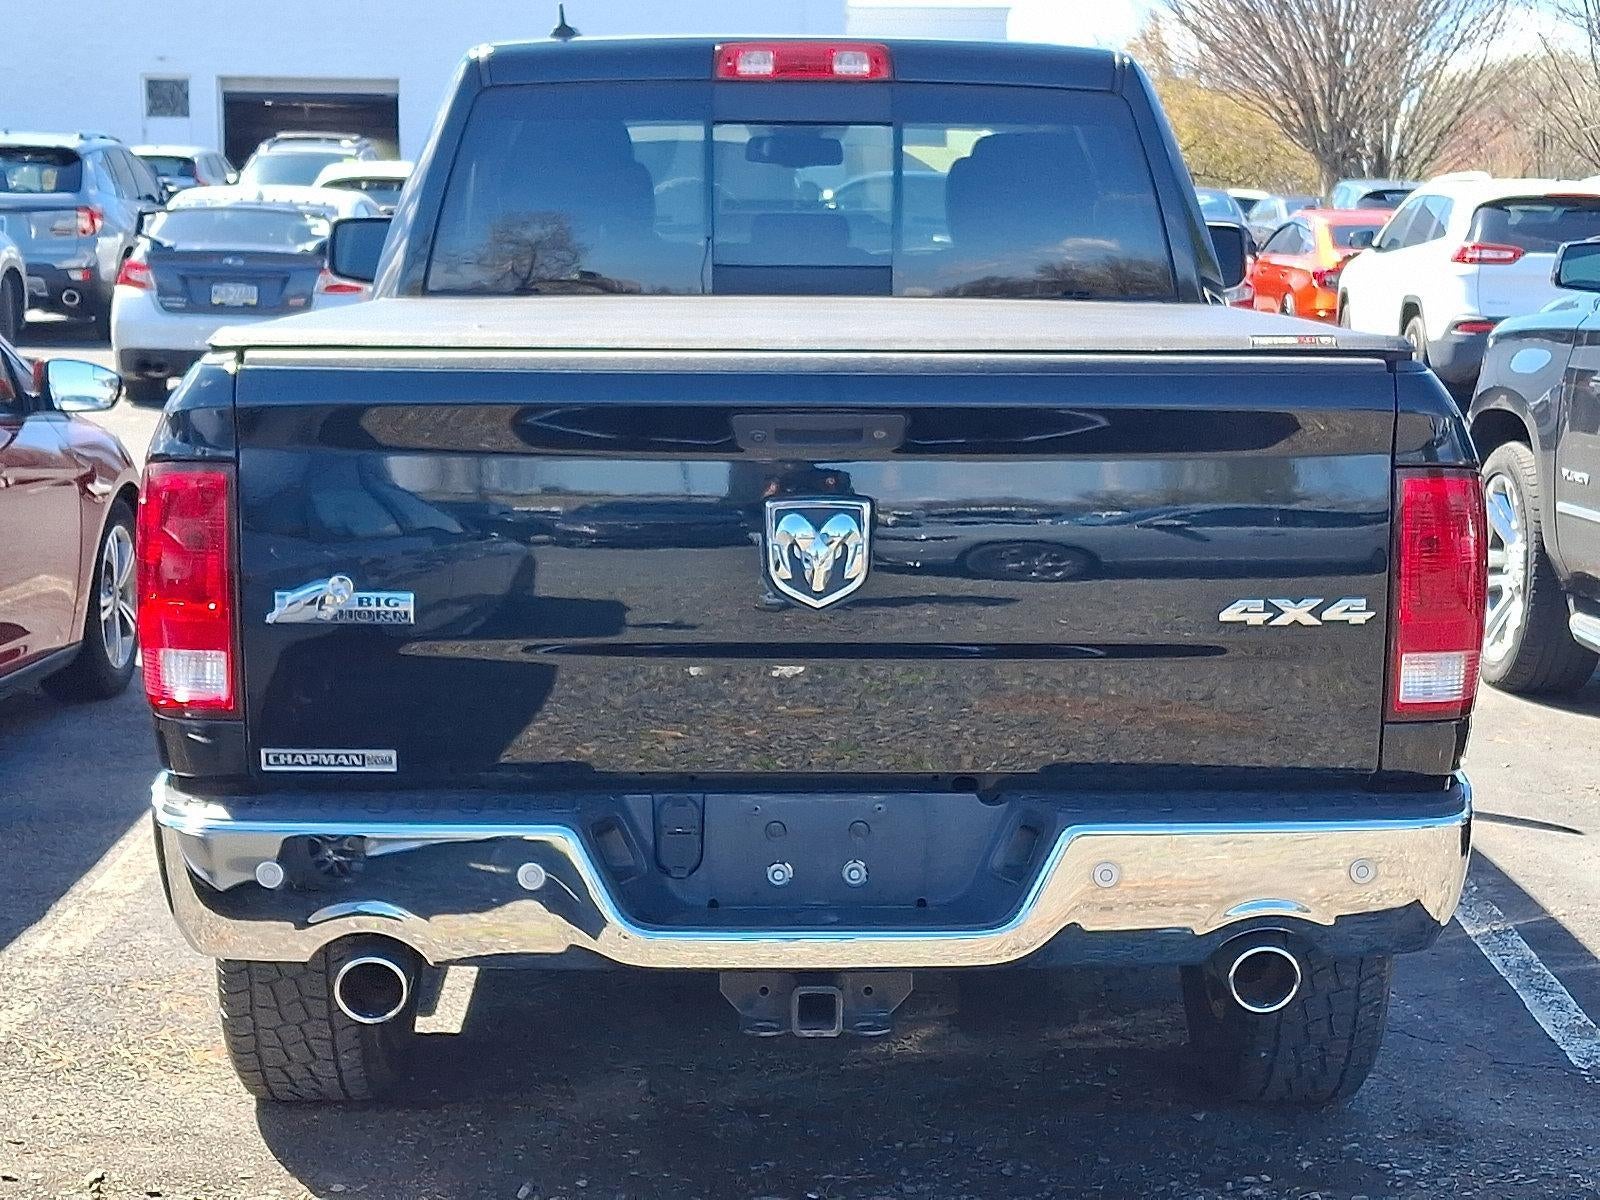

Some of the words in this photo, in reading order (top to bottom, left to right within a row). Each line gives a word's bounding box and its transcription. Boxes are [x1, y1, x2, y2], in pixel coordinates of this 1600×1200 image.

[357, 596, 399, 608] BIG
[338, 609, 409, 622] HORN
[1218, 598, 1377, 626] 4X4
[267, 753, 363, 766] CHAPMAN
